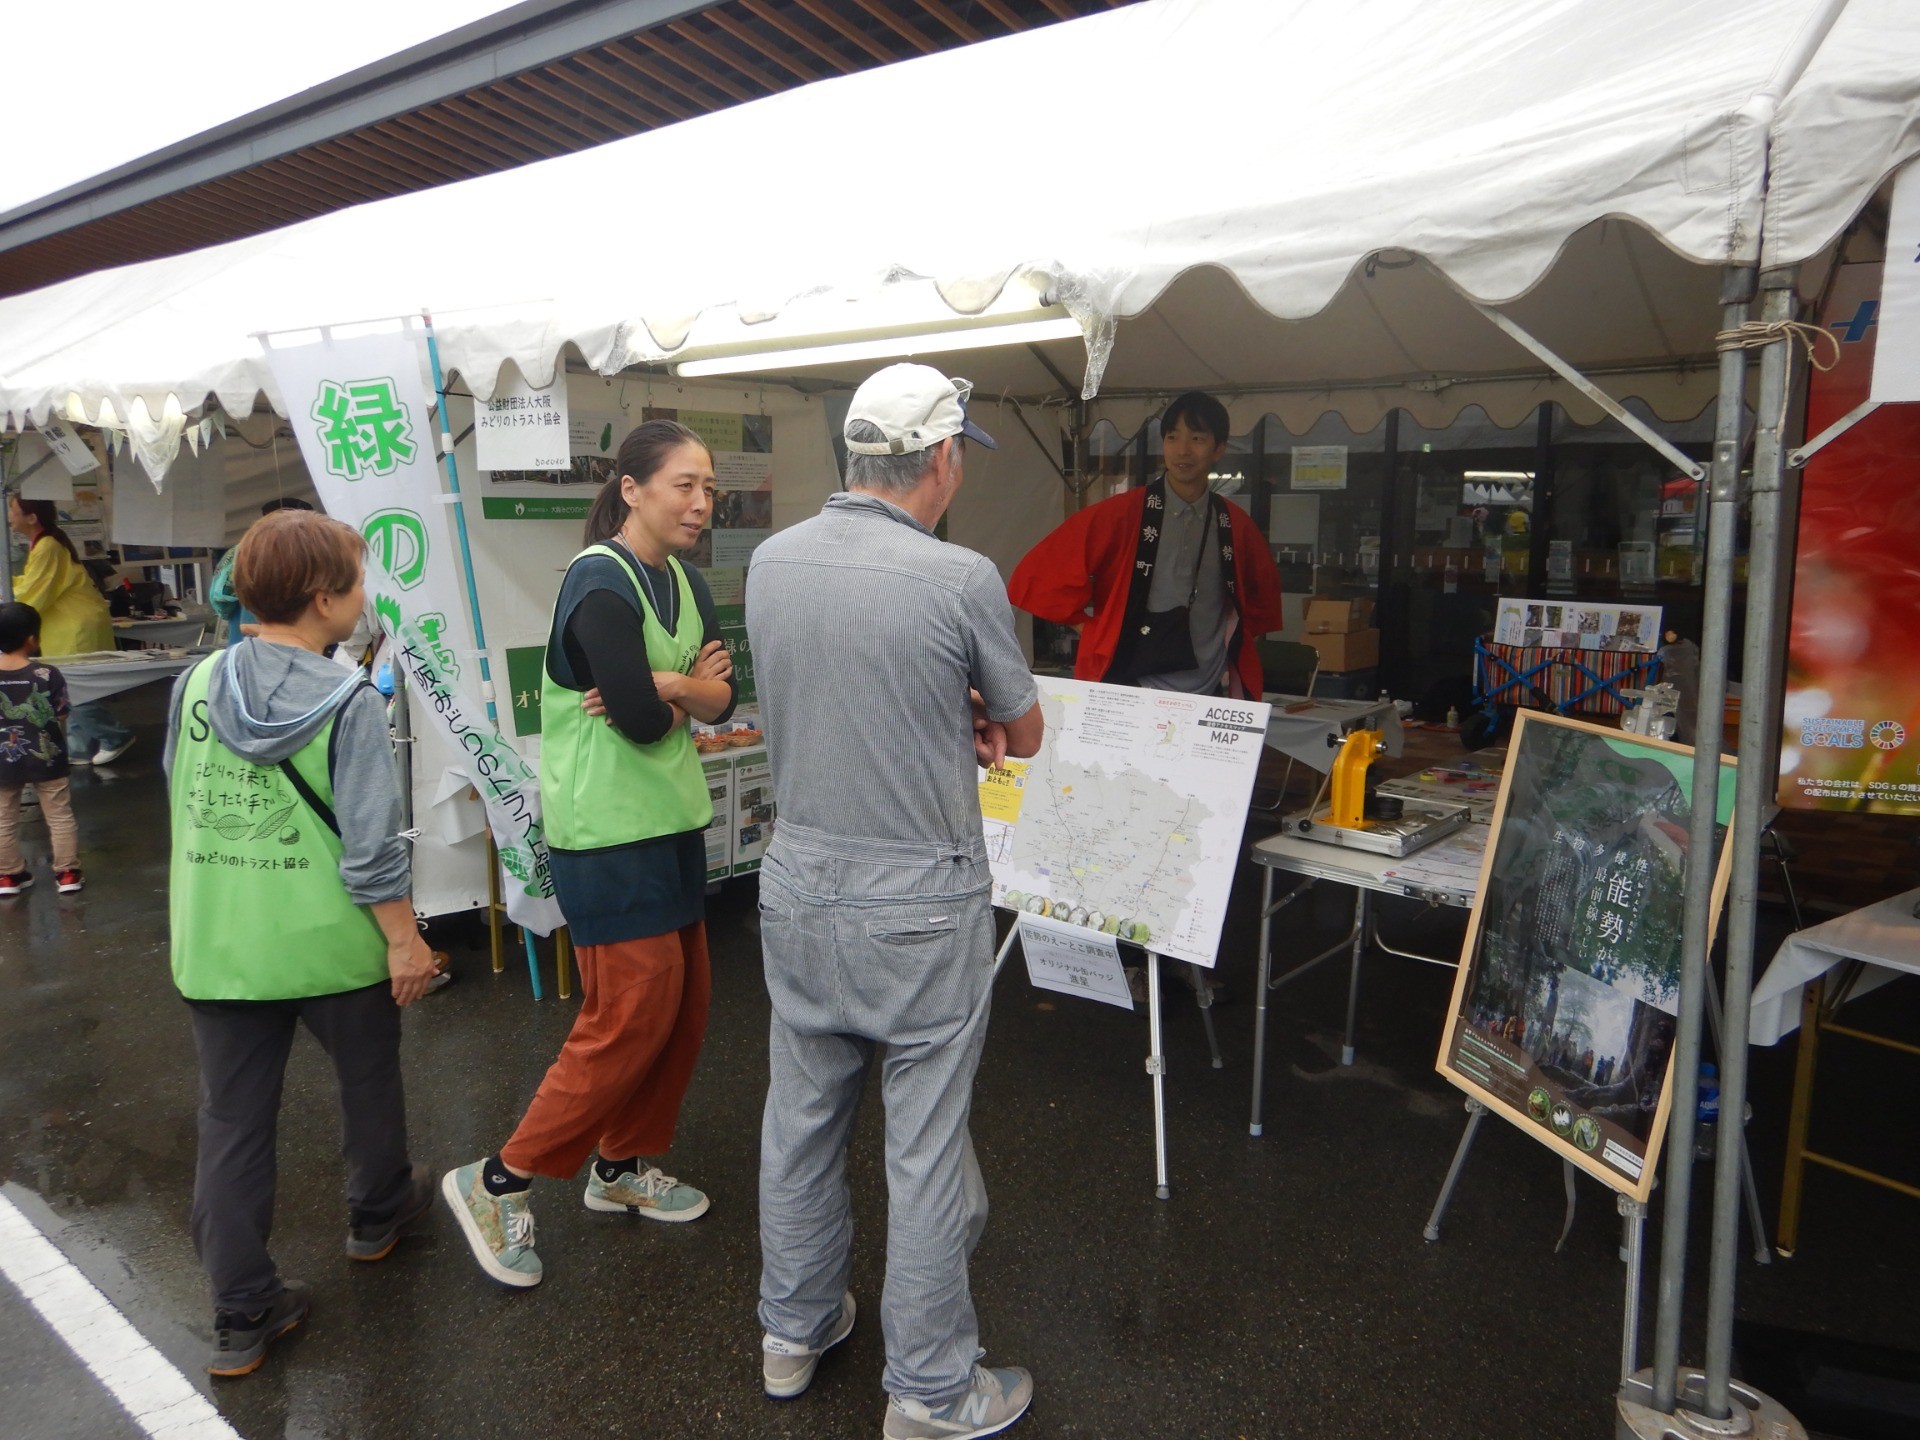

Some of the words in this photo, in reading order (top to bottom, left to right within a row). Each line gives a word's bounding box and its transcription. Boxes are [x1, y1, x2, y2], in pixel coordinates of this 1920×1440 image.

[488, 395, 551, 411] 公益財団法人大阪
[481, 412, 561, 428] みどりのトラスト協会
[1136, 494, 1163, 576] 能勢町
[1205, 707, 1254, 725] ACCESS
[1802, 717, 1865, 727] SUSTAINABLE
[1210, 730, 1239, 745] MAP
[1802, 725, 1865, 734] DEVELOPMENT
[1801, 732, 1865, 748] GOALS
[401, 645, 555, 899] 大阪みどりのトラスト協会
[1024, 929, 1114, 959] 能勢のえーとこ調査中
